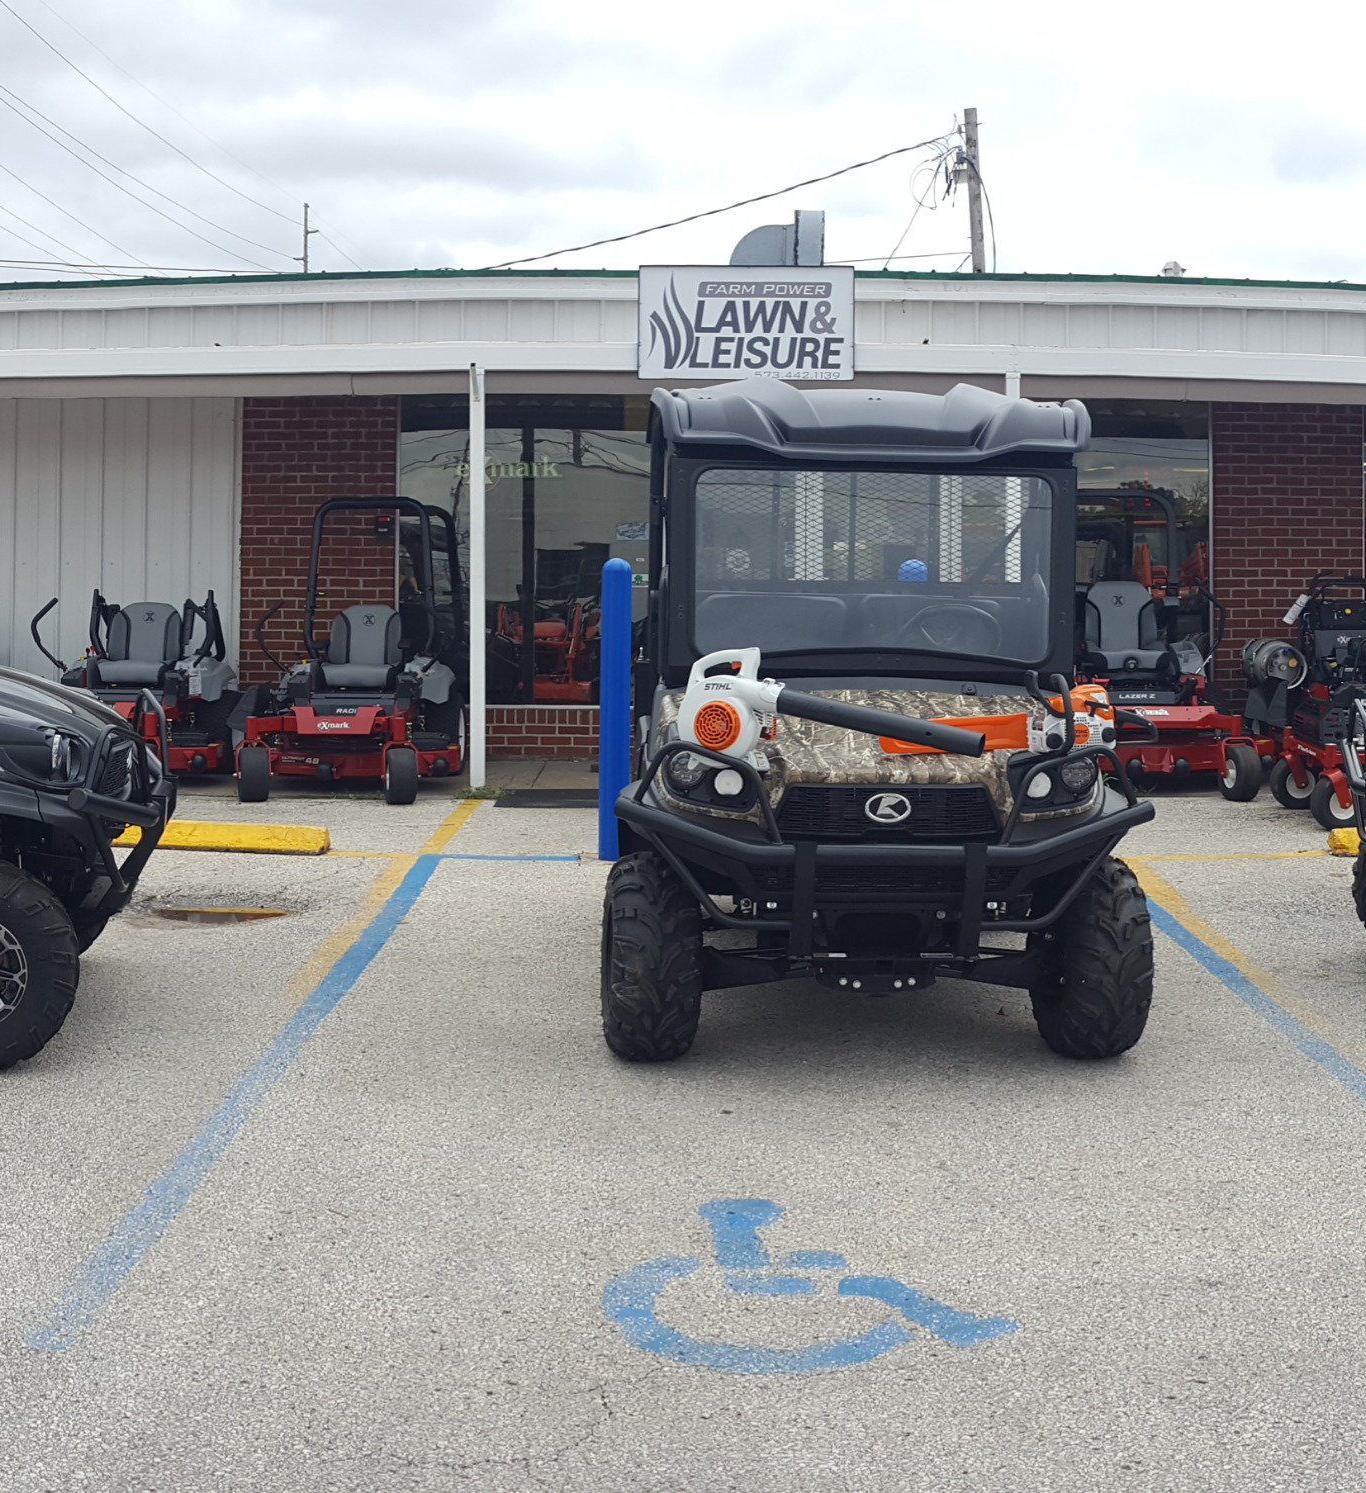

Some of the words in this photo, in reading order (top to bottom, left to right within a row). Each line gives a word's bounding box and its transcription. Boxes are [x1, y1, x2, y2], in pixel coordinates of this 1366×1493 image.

[705, 284, 756, 295] FARM
[762, 284, 826, 296] POWER
[688, 336, 845, 370] LEISURE
[703, 682, 733, 691] STIHL
